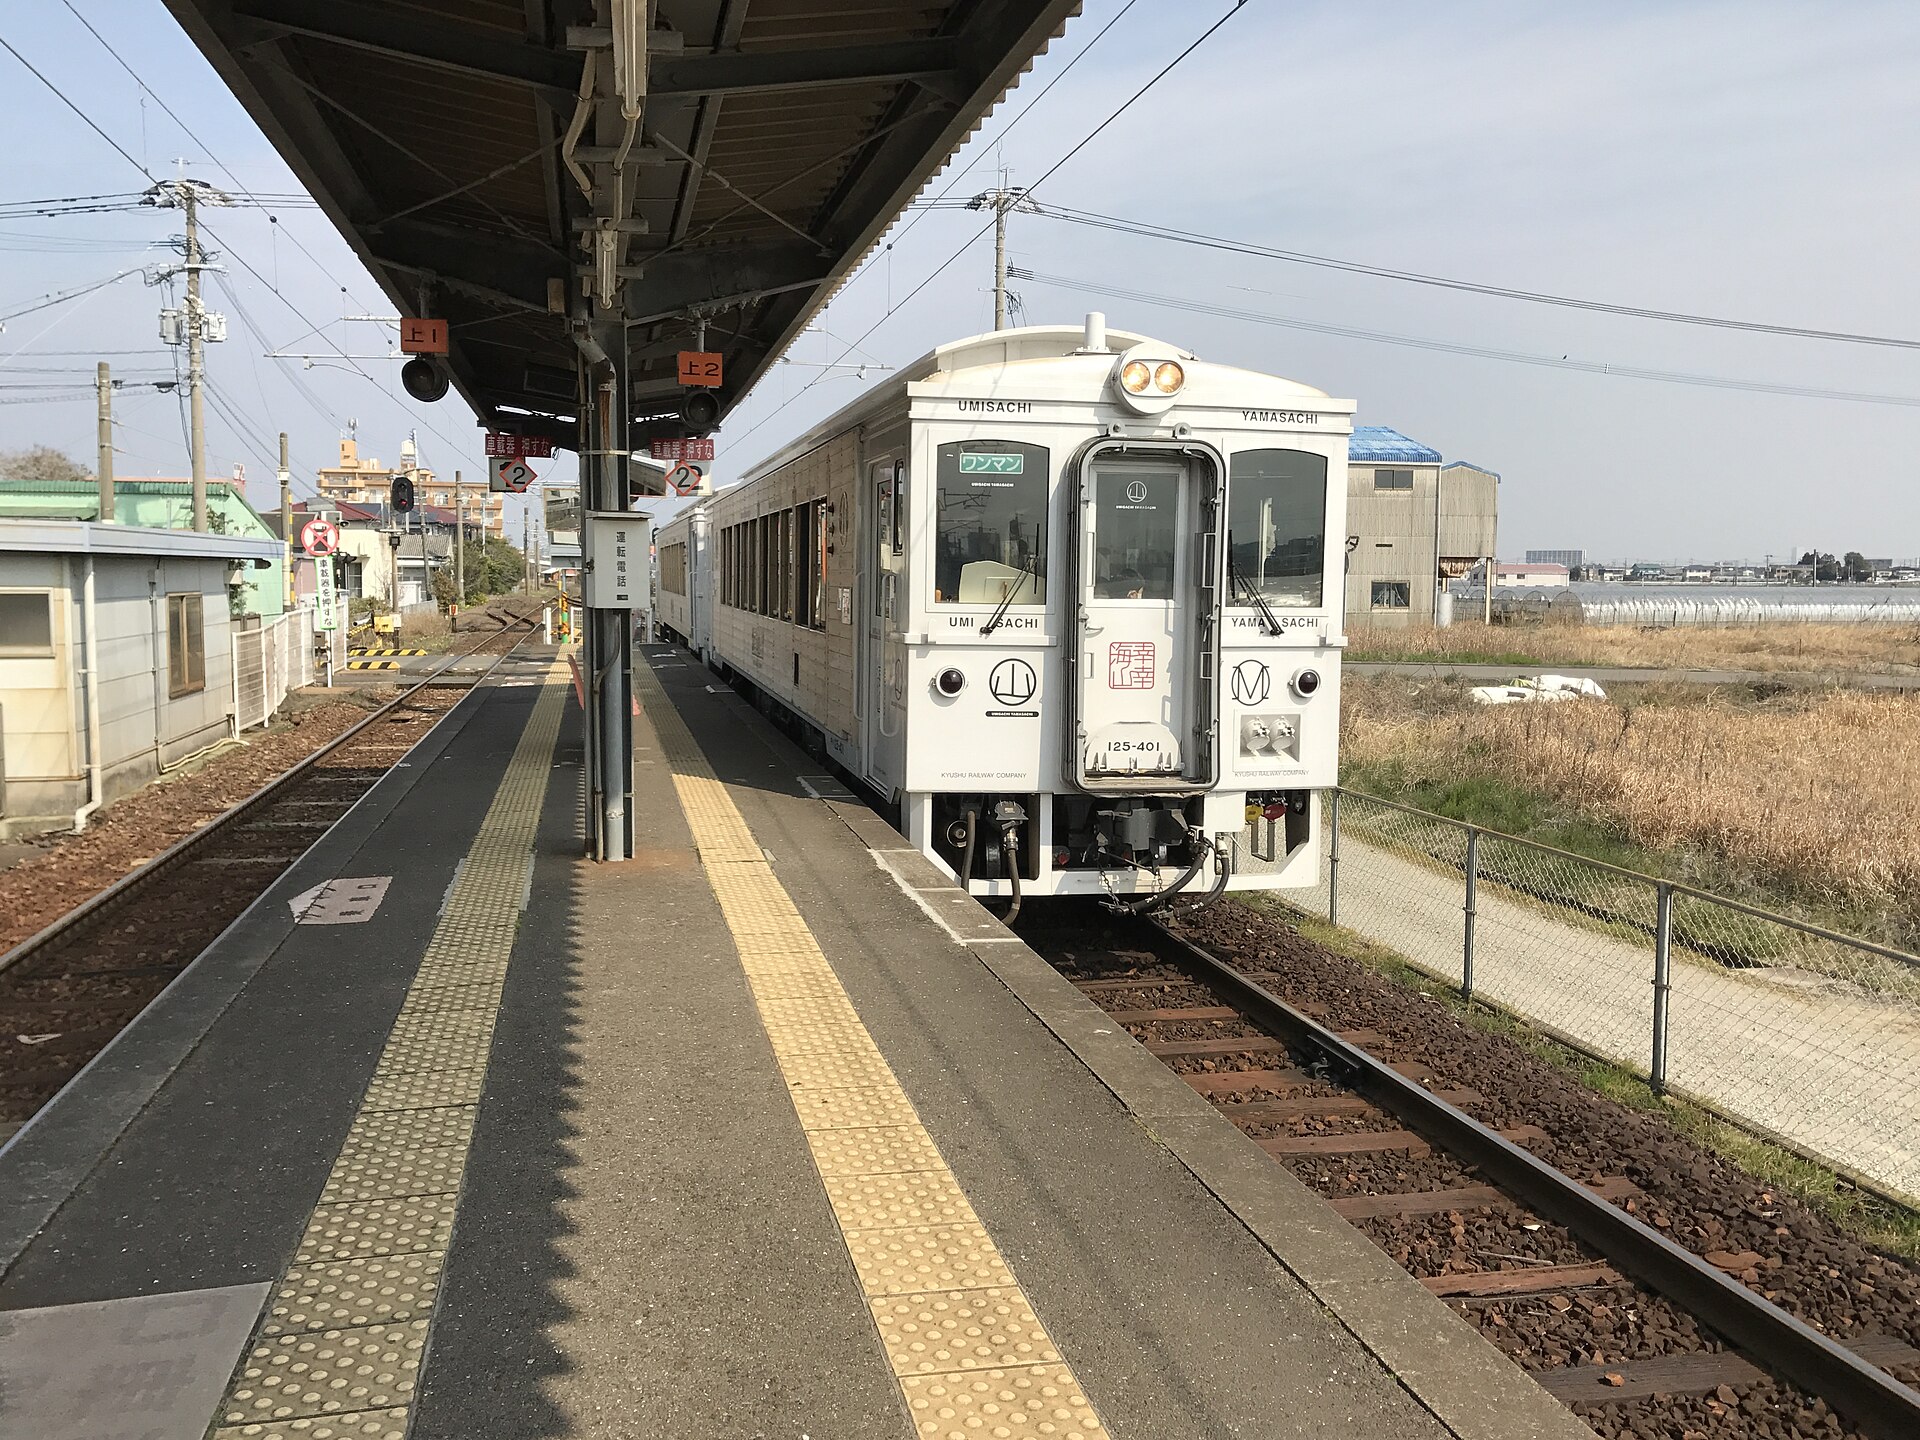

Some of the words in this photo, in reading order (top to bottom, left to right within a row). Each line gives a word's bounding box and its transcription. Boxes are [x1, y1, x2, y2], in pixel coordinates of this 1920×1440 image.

[682, 360, 719, 377] 上2
[958, 400, 1032, 413] UMISACHI
[1242, 410, 1318, 424] YAMASACHI
[487, 435, 516, 454] 車載器
[521, 436, 550, 456] 押すな
[653, 441, 680, 459] 車載器
[685, 441, 713, 459] 押すな
[962, 455, 1021, 471] ワンマン
[512, 466, 526, 485] 2
[676, 466, 691, 488] 2
[616, 531, 626, 587] 運転電話
[949, 617, 975, 627] UMI
[996, 618, 1038, 629] SACHI
[1231, 617, 1265, 628] YAMA
[1281, 617, 1318, 628] SACHI
[1108, 742, 1160, 752] 125-401
